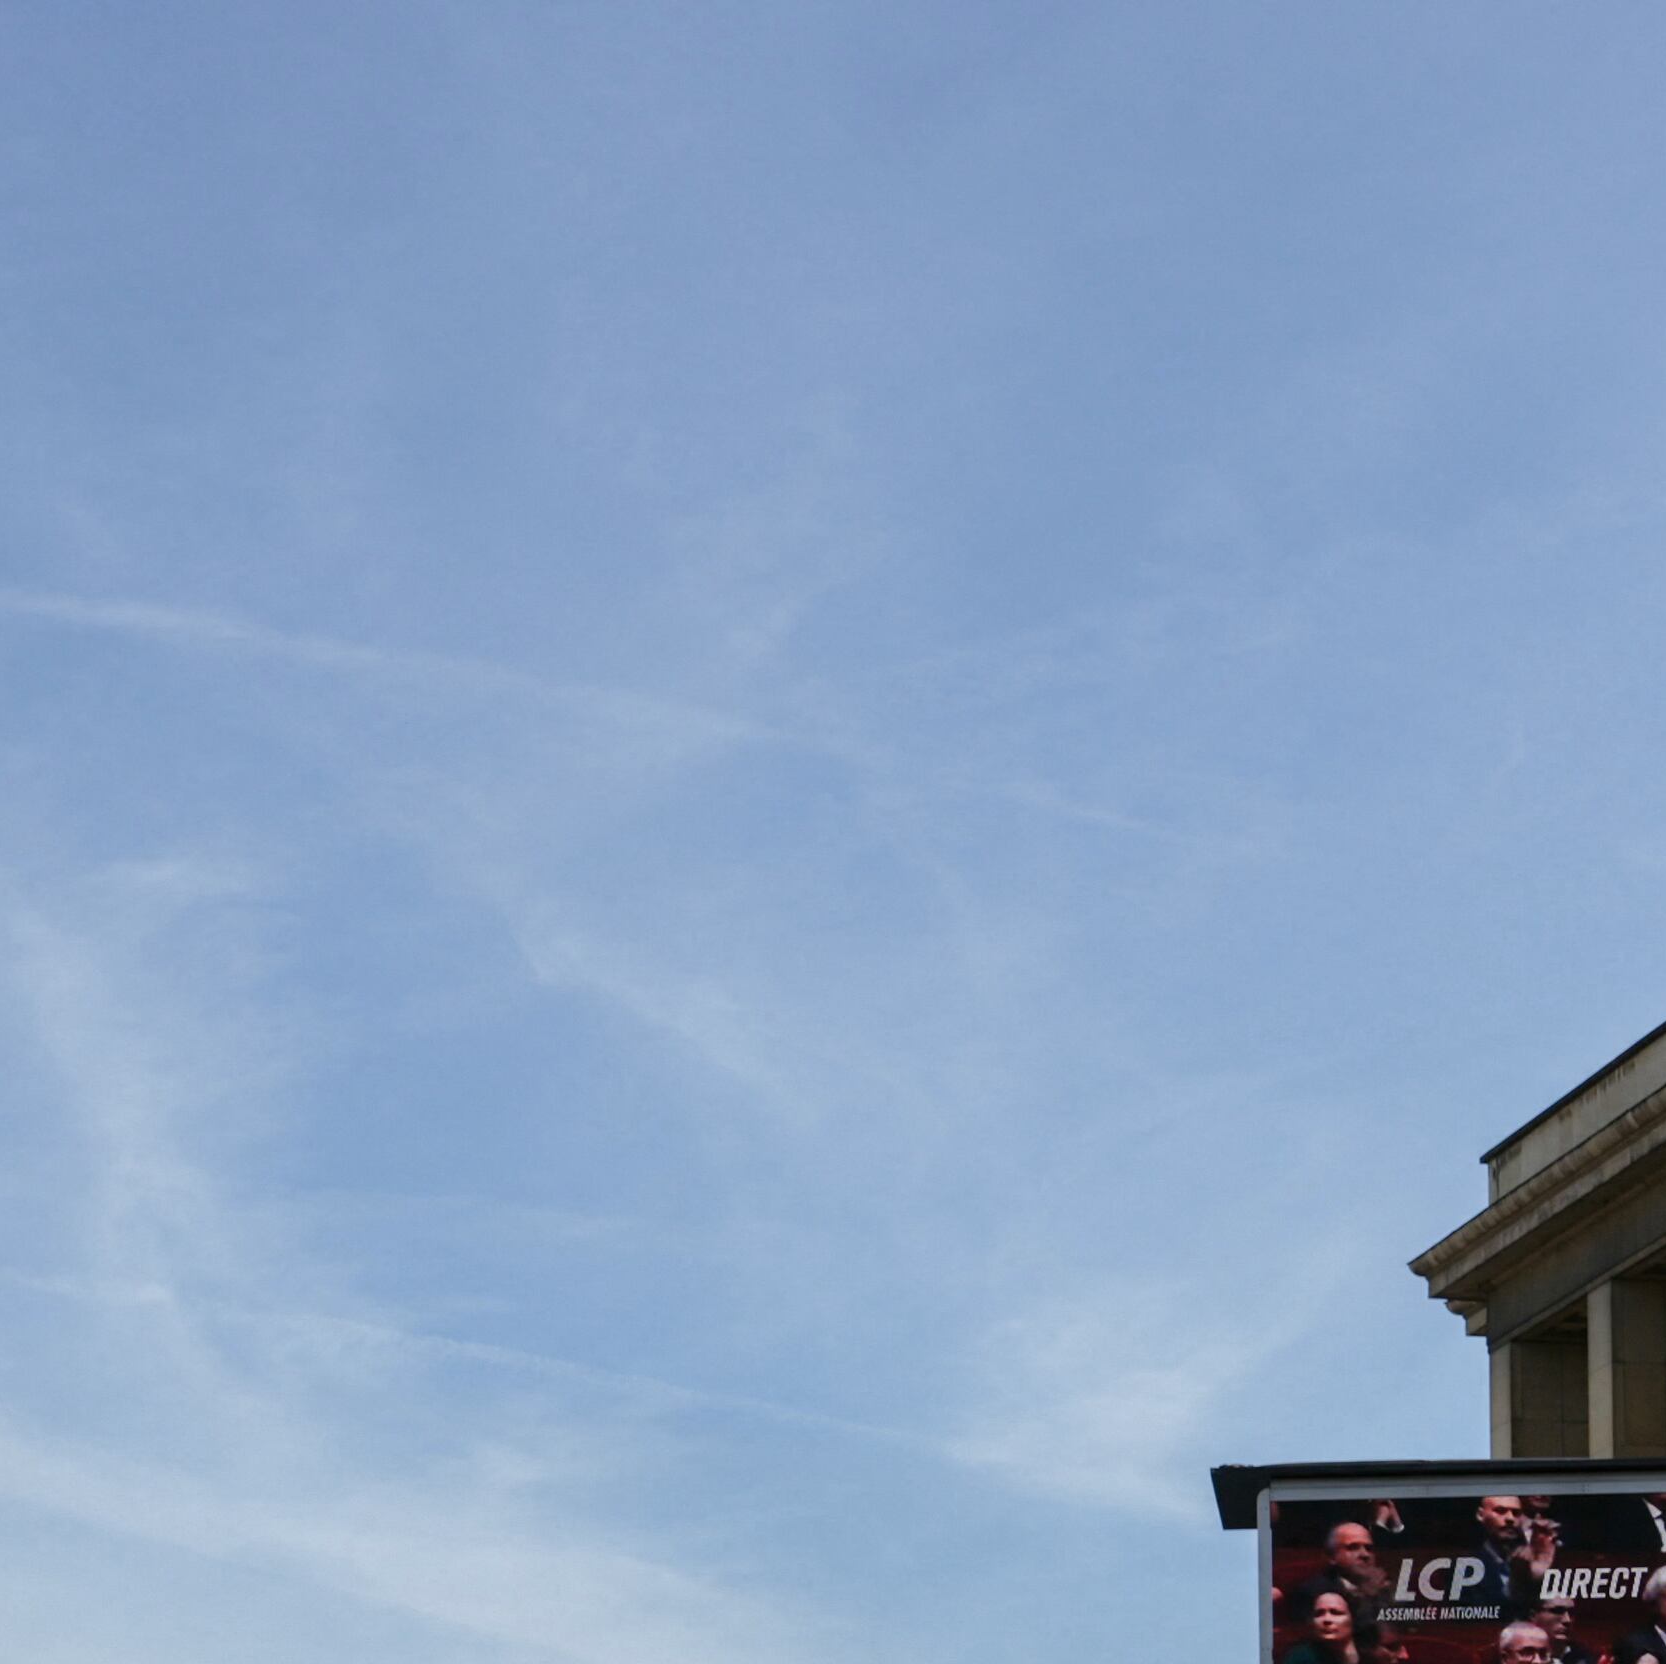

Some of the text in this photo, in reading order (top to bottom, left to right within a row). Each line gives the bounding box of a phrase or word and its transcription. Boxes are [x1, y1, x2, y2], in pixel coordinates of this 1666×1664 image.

[1394, 1557, 1486, 1601] LCP
[1539, 1566, 1649, 1600] DIRECT
[1377, 1604, 1437, 1621] ASSEMBLÉE
